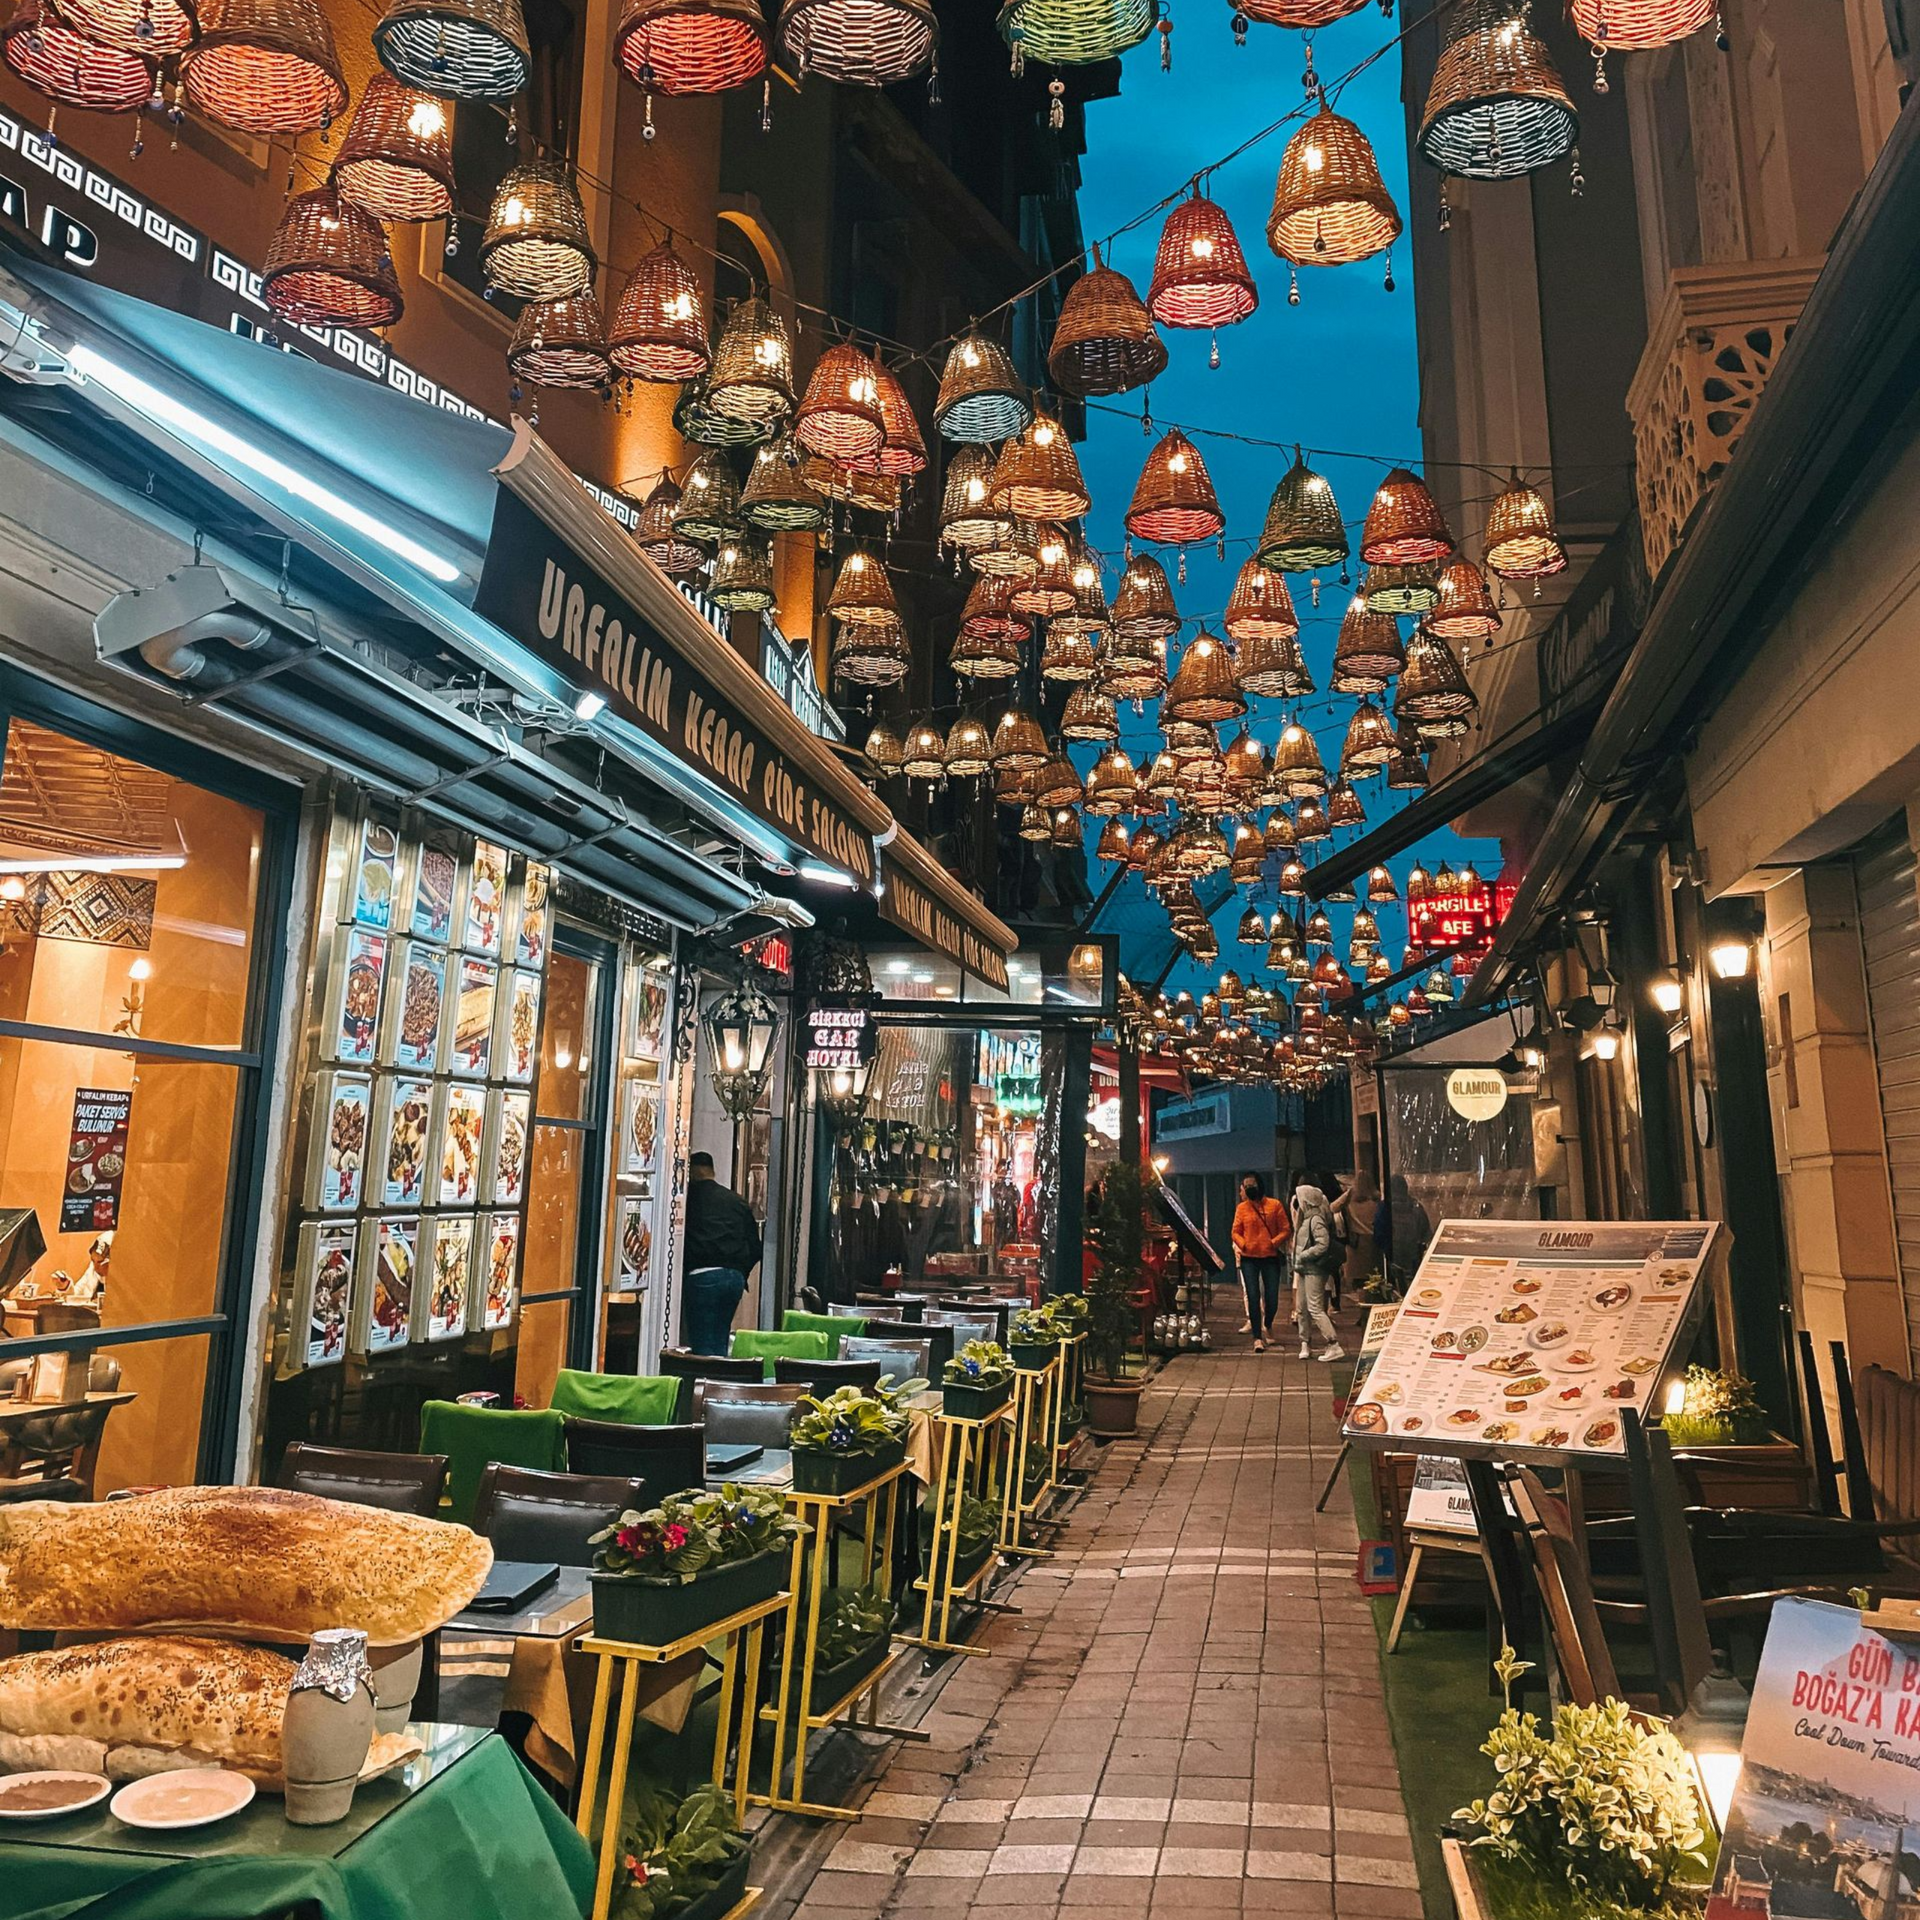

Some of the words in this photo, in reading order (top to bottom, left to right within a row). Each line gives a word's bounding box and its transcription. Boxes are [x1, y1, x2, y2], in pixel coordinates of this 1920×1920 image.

[538, 558, 672, 733] URFALIM
[684, 690, 755, 795] KEBAP
[764, 756, 805, 835] PİDE
[812, 798, 870, 879] SALONU
[893, 874, 933, 939] URFALIM
[936, 909, 961, 958] KEBAP
[963, 926, 981, 971] PİDE
[981, 944, 1007, 987] SALONU
[1441, 919, 1474, 935] AFE
[814, 1029, 858, 1048] GAR
[807, 1050, 861, 1067] HOTEL
[1452, 1080, 1501, 1096] GLAMOUR
[106, 1093, 126, 1102] KEBAP
[75, 1104, 101, 1118] PAKET
[100, 1104, 128, 1120] SERVİS
[77, 1119, 115, 1133] BULUNUR
[1538, 1232, 1594, 1248] GLAMOUR
[1848, 1638, 1894, 1687] GÜN
[1792, 1670, 1883, 1730] BOĞAZ'A
[1794, 1718, 1828, 1740] Cool
[1826, 1726, 1866, 1753] Down
